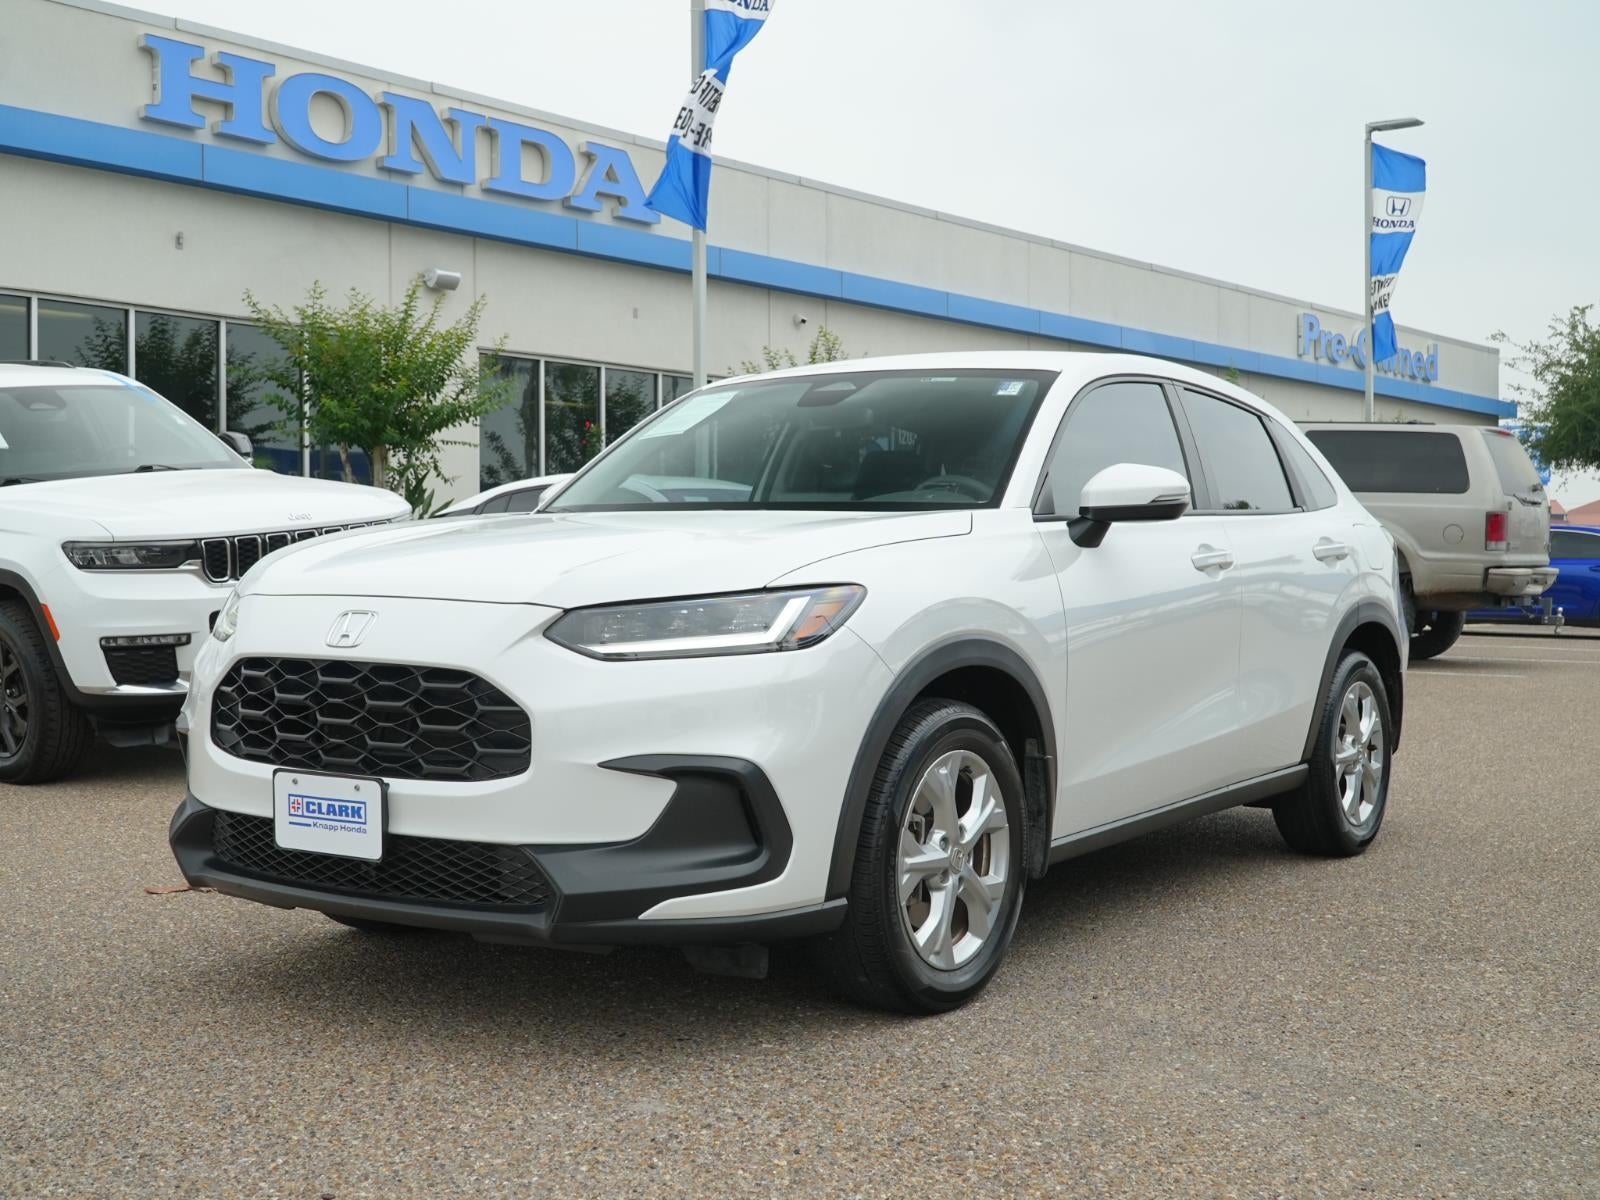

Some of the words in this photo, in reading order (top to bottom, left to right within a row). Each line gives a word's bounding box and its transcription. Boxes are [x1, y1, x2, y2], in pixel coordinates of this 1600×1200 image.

[138, 34, 660, 224] HONDA
[1372, 216, 1415, 229] HONDA
[305, 801, 363, 819] CLARK
[312, 821, 339, 832] Knapp
[340, 825, 367, 834] Honda
